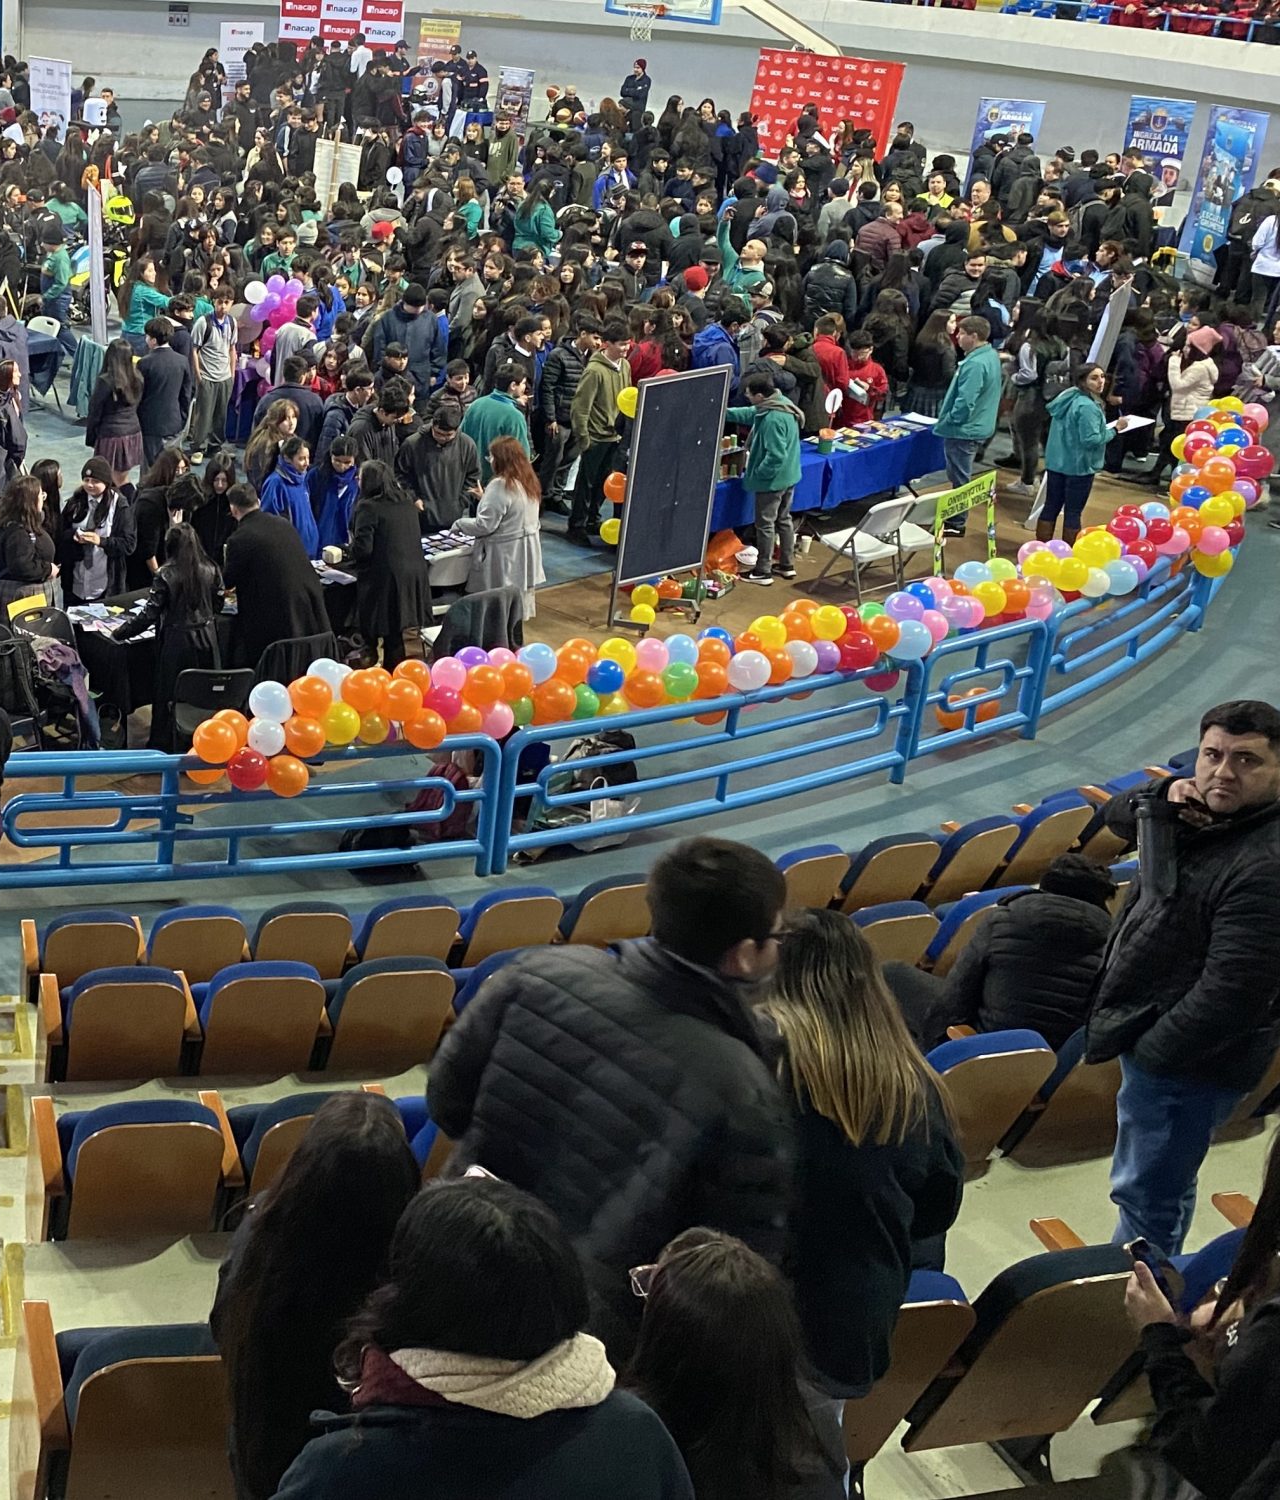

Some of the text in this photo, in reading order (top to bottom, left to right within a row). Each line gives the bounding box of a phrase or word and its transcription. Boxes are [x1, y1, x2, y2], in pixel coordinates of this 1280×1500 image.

[1133, 130, 1178, 143] INGRESA A LA
[1129, 137, 1178, 155] ARMADA
